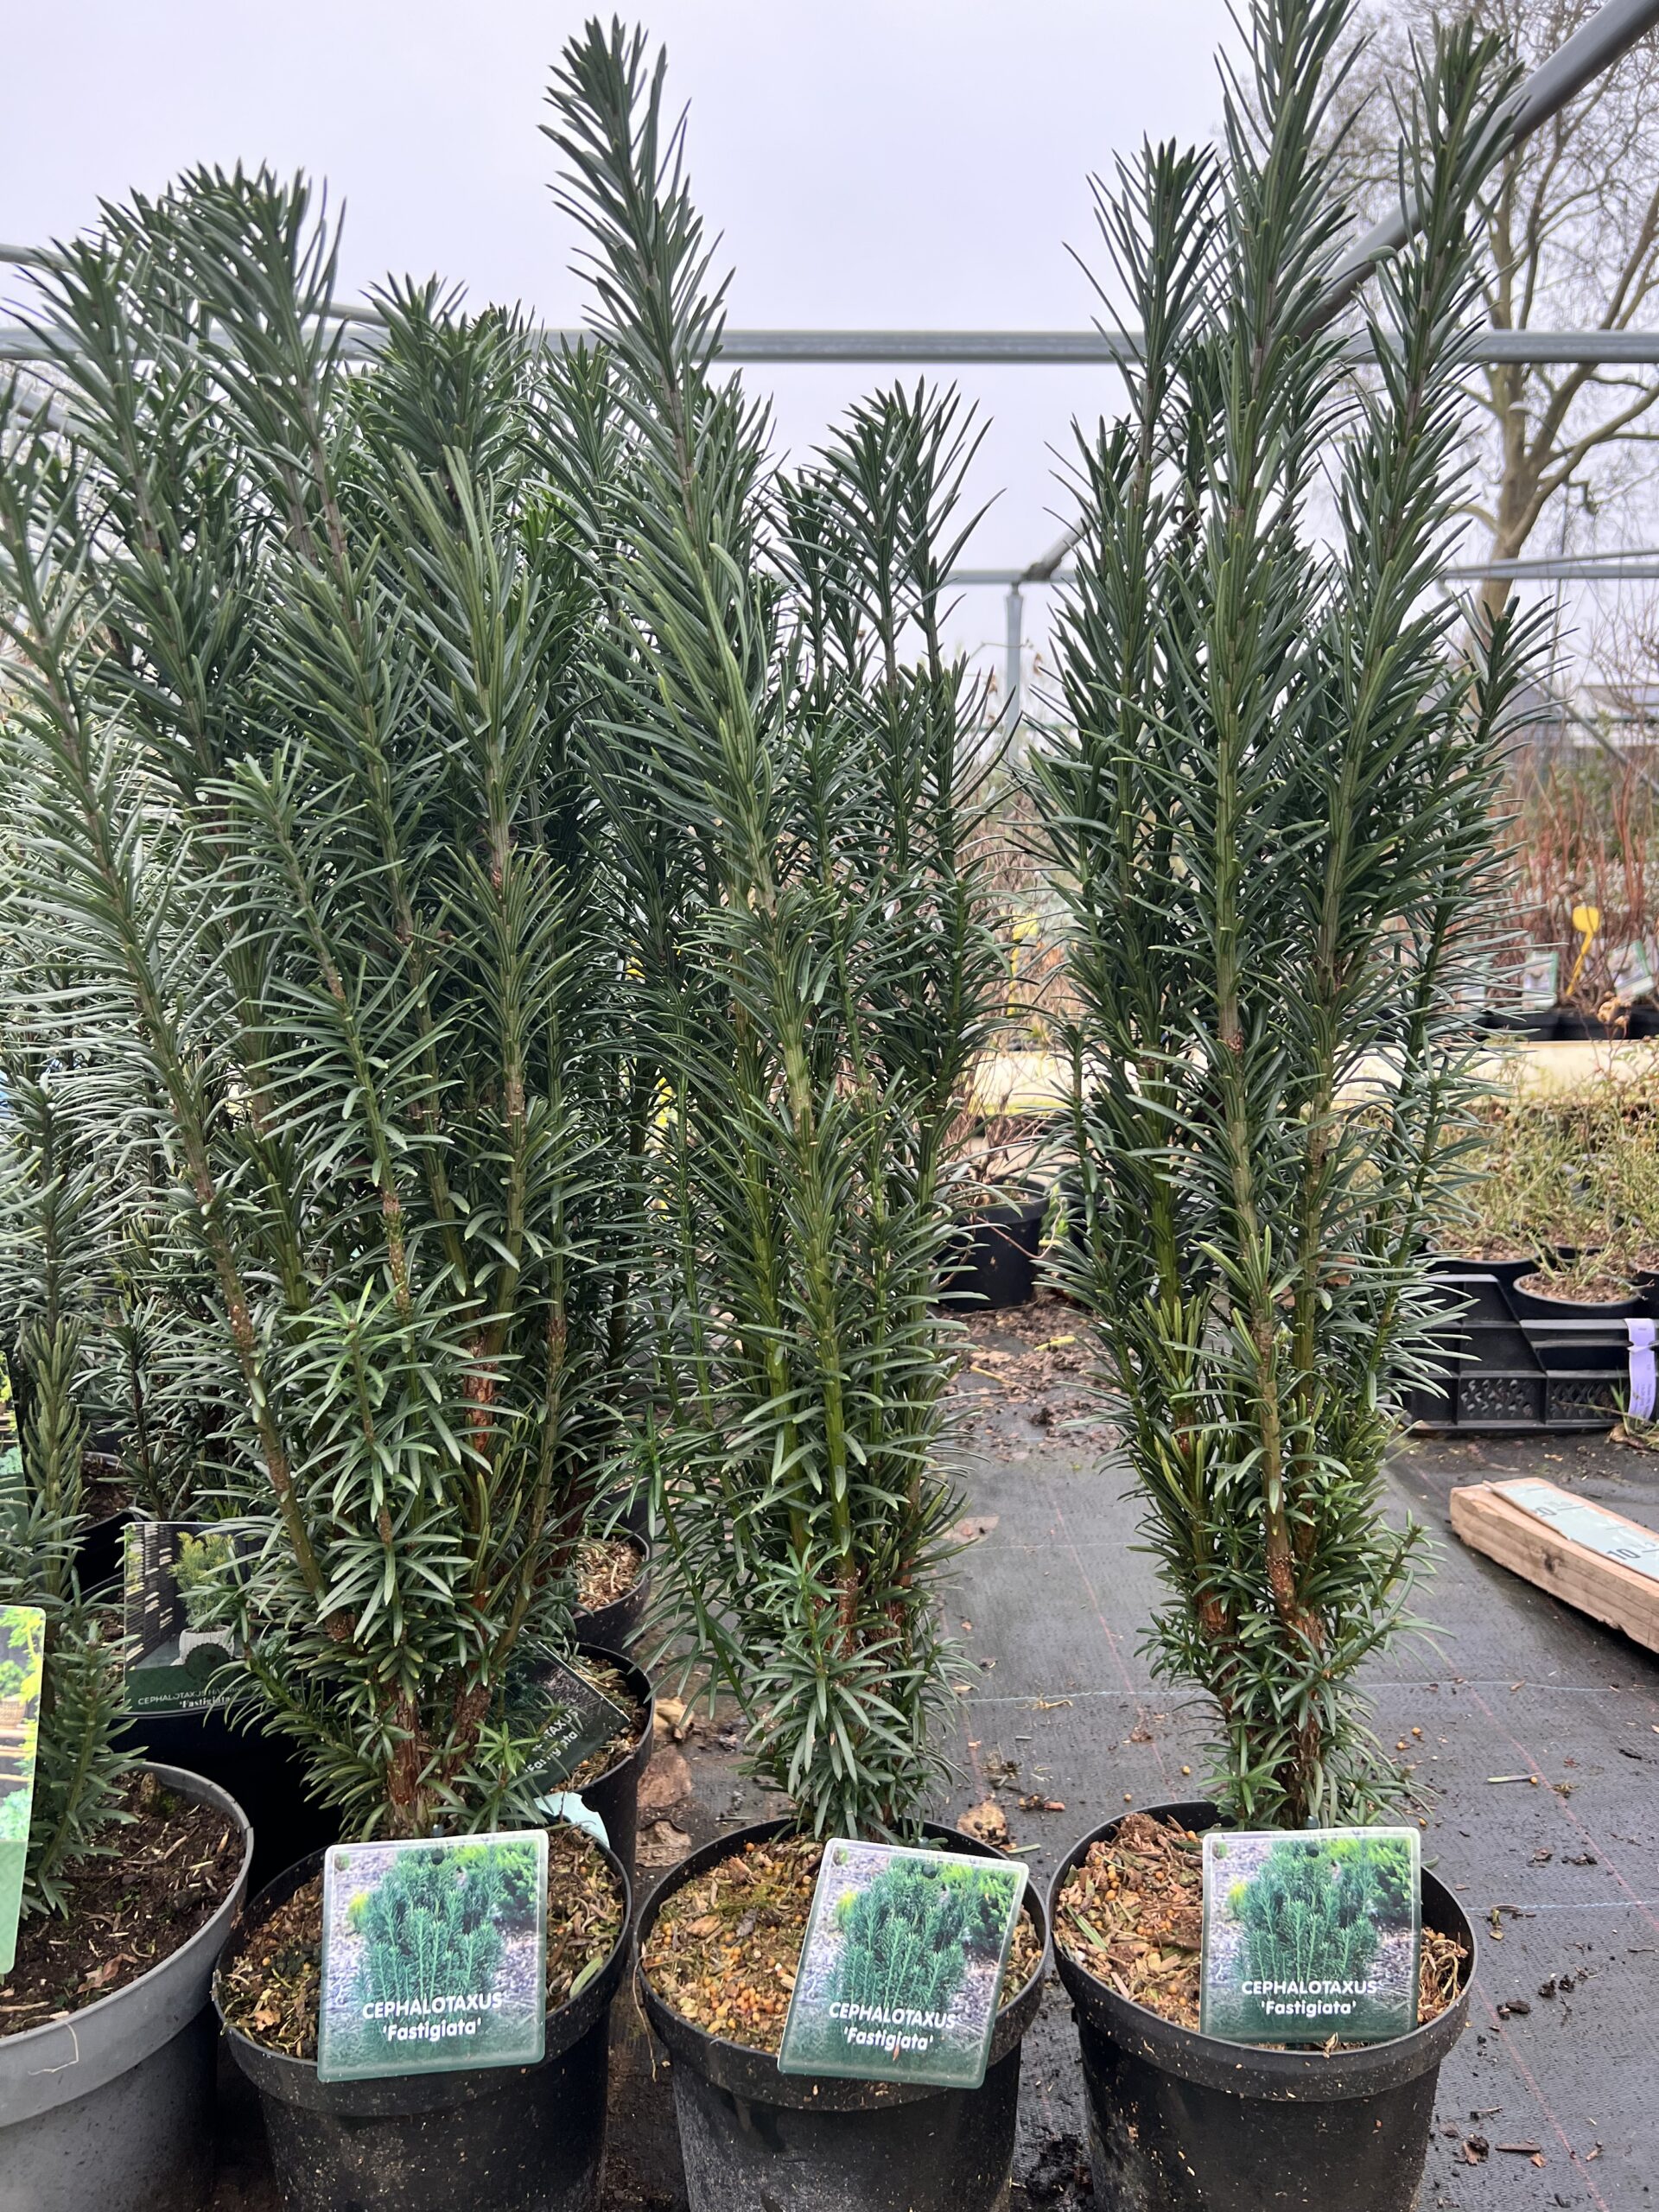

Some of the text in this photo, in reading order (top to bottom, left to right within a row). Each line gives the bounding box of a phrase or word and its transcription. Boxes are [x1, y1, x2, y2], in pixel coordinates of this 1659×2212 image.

[1606, 1548, 1642, 1560] 10
[1241, 1980, 1378, 1995] CEPHALOTAXUS
[362, 1992, 504, 2019] CEPHALOTAXUS
[828, 2001, 957, 2030] CEPHALOTAXUS
[1261, 1999, 1357, 2018] 'Fastigiata'
[382, 2017, 483, 2042] 'Fastigiata'
[843, 2026, 934, 2051] 'Fastigiata'
